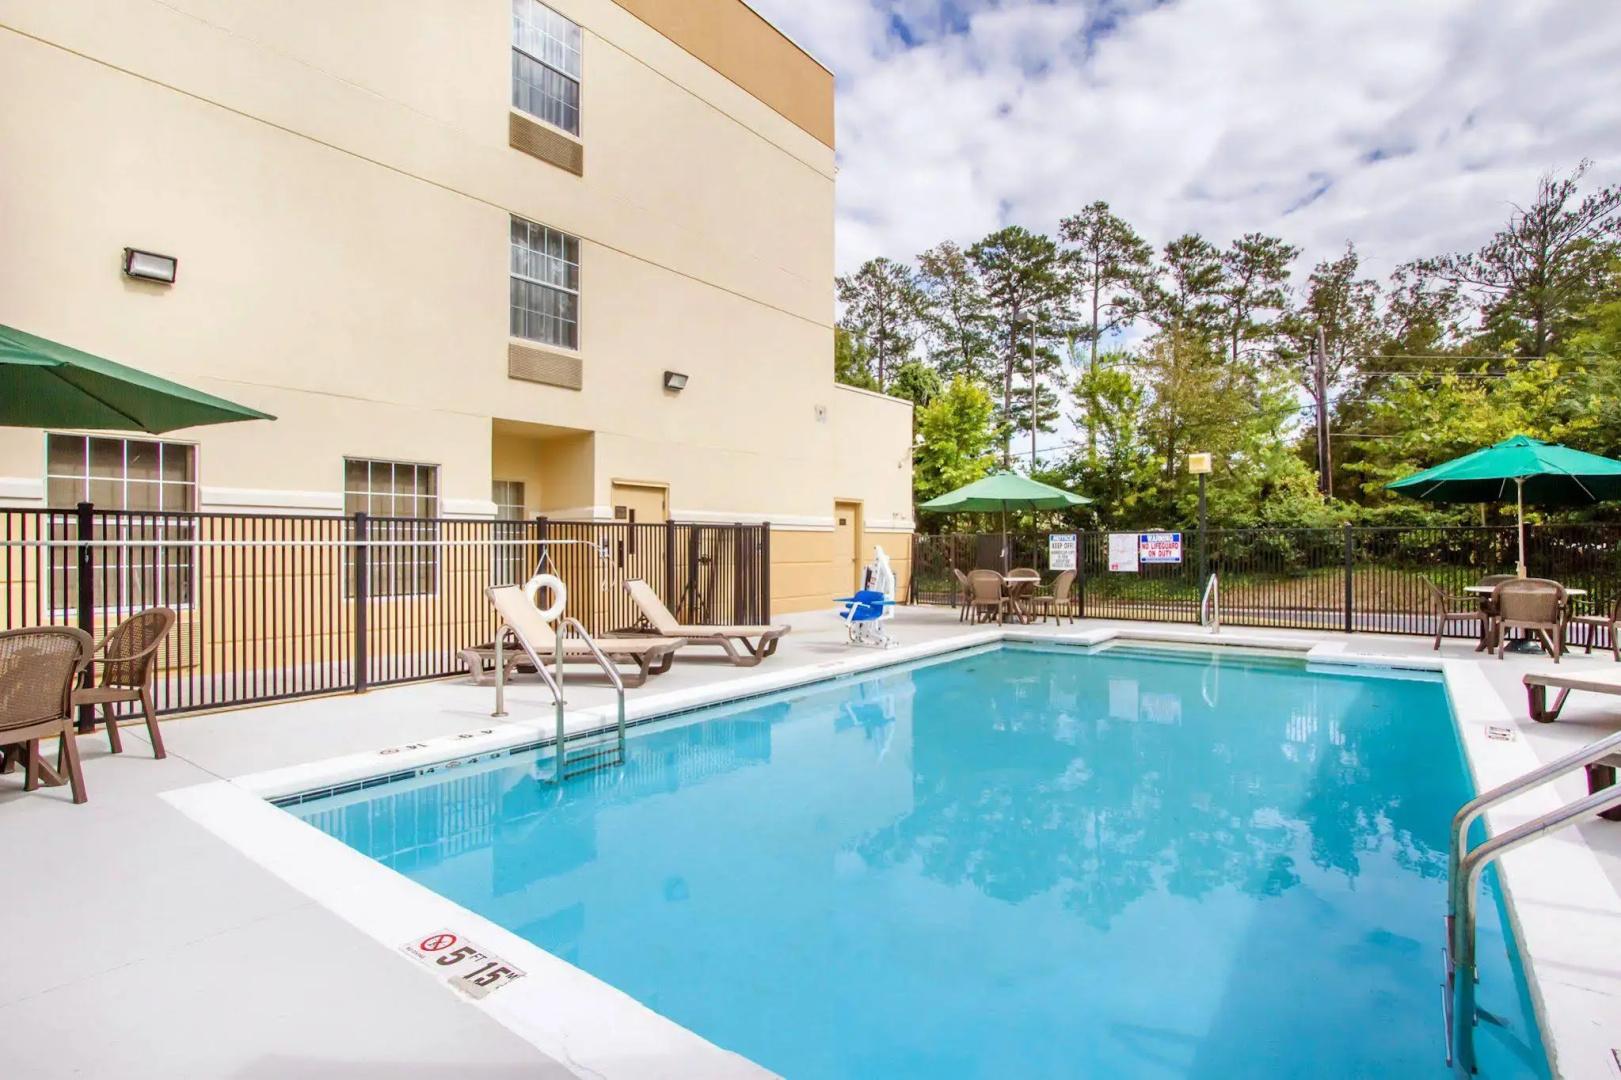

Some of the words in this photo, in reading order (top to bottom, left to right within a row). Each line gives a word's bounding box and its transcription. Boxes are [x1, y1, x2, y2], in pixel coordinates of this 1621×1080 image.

[1151, 542, 1179, 550] LIFEGUARD
[1158, 549, 1172, 557] DUTY
[436, 946, 477, 966] 5
[469, 953, 488, 963] FT
